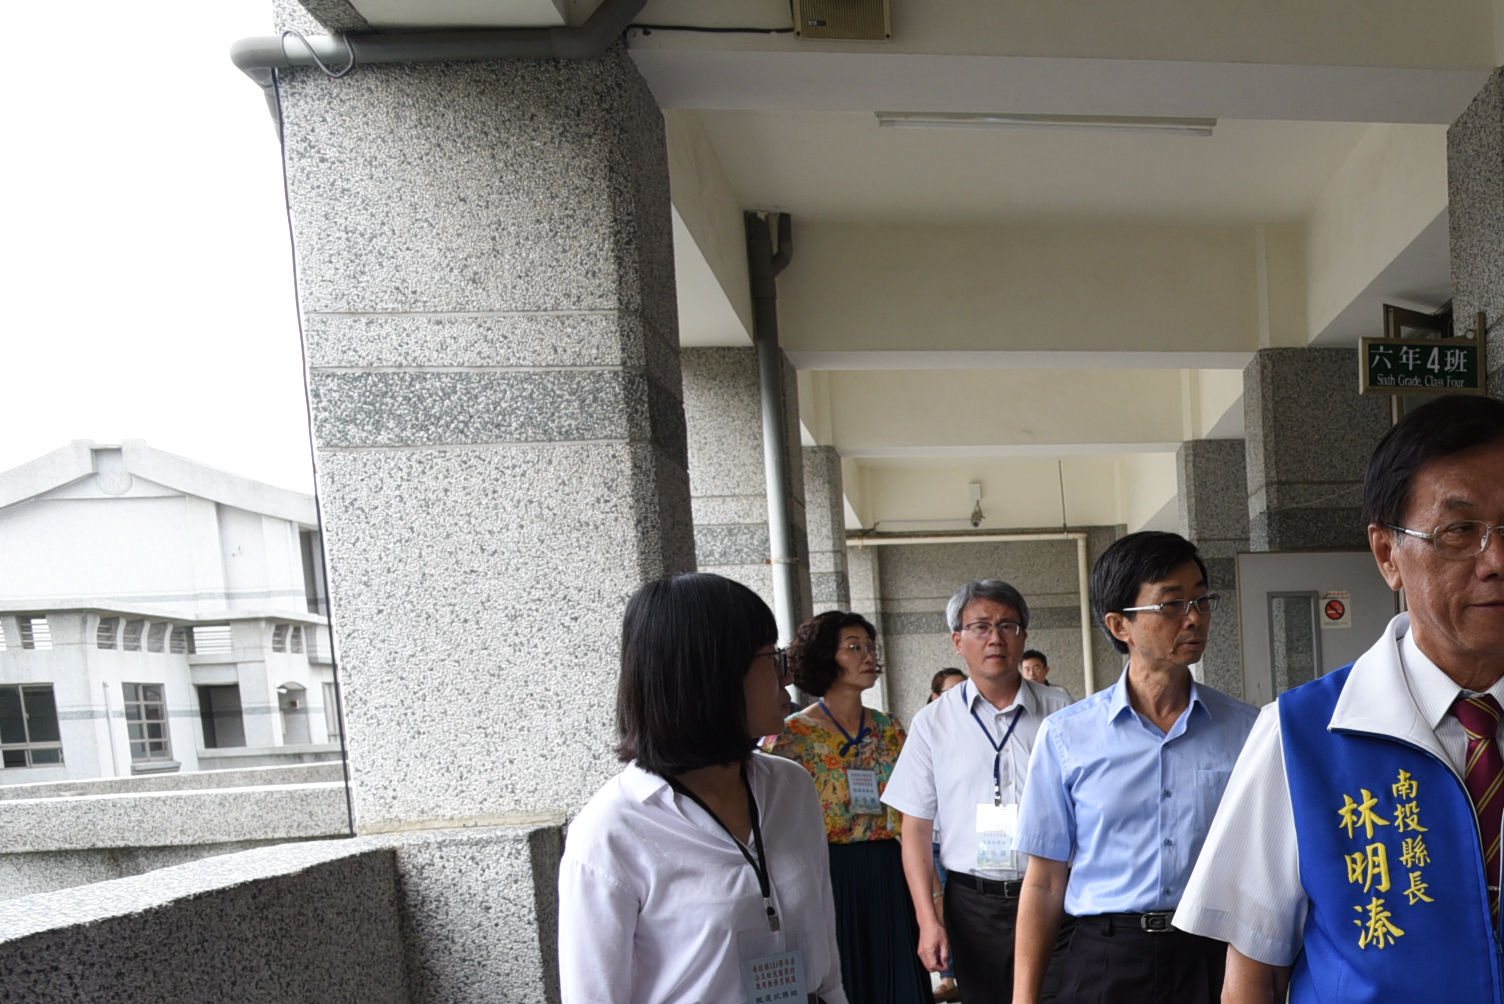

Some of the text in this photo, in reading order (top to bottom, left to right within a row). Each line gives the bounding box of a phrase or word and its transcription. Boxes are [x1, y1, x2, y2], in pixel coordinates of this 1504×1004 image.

[1370, 345, 1468, 374] 六年4班
[1377, 373, 1396, 386] Sixth
[1424, 374, 1444, 387] Class
[1447, 375, 1465, 388] Four
[1338, 788, 1405, 949] 林明溱
[1392, 768, 1435, 905] 南投縣長
